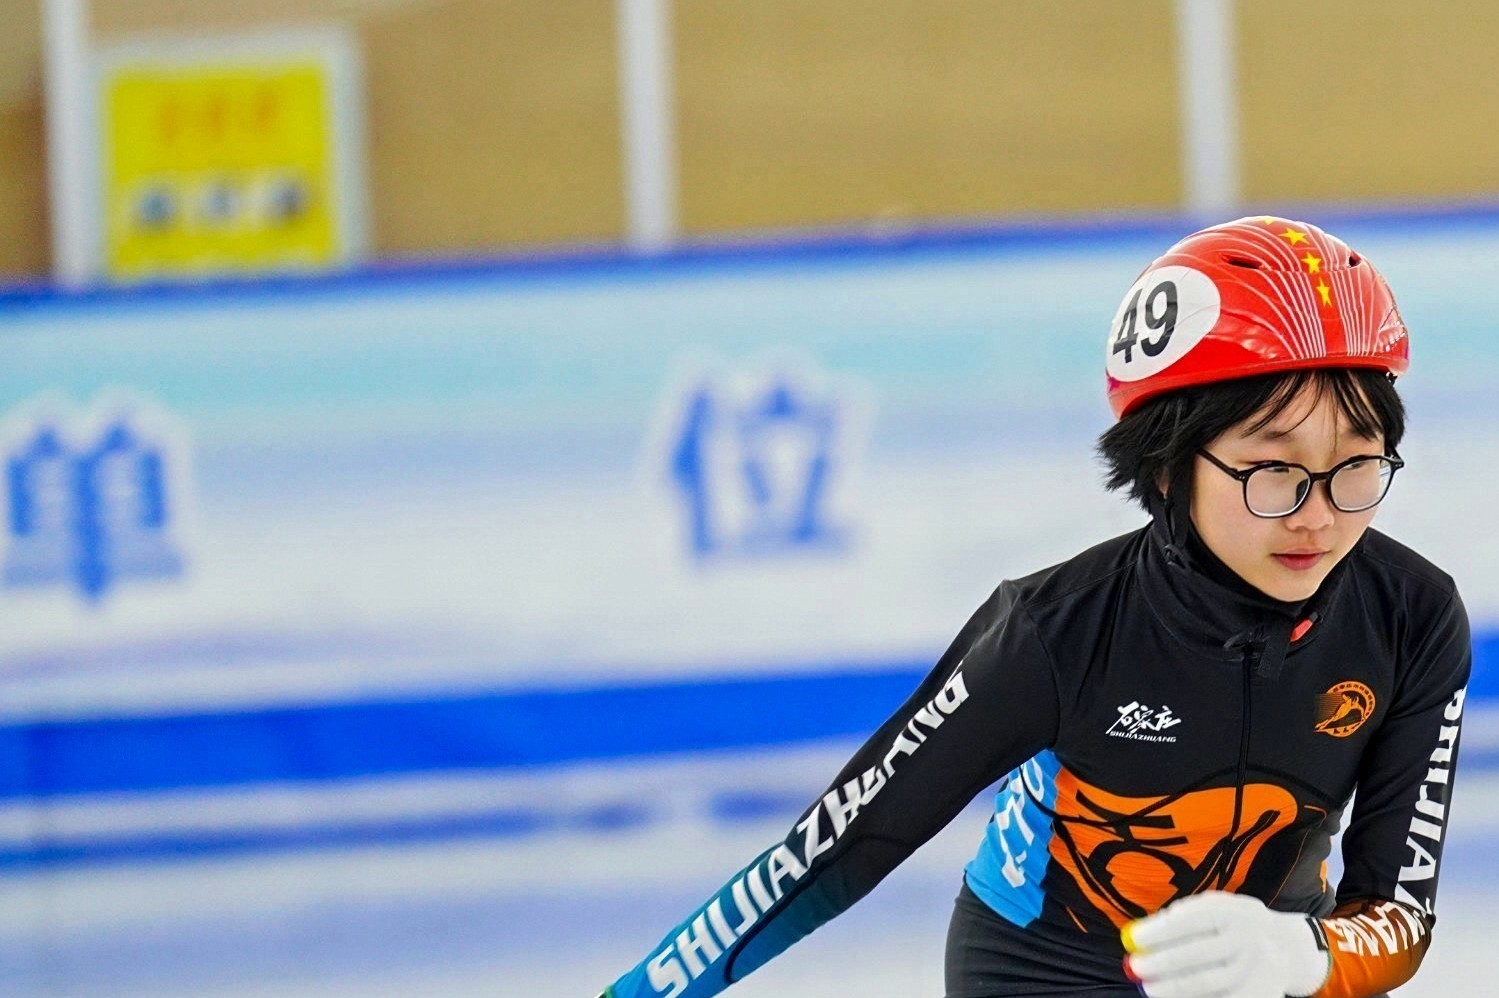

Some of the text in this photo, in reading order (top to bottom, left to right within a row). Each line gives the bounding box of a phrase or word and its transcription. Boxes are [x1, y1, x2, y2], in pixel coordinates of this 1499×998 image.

[1111, 280, 1179, 364] 49
[666, 380, 852, 562] 位
[1105, 701, 1181, 734] 石家庄
[1109, 731, 1177, 743] SHIJIAZHUANG
